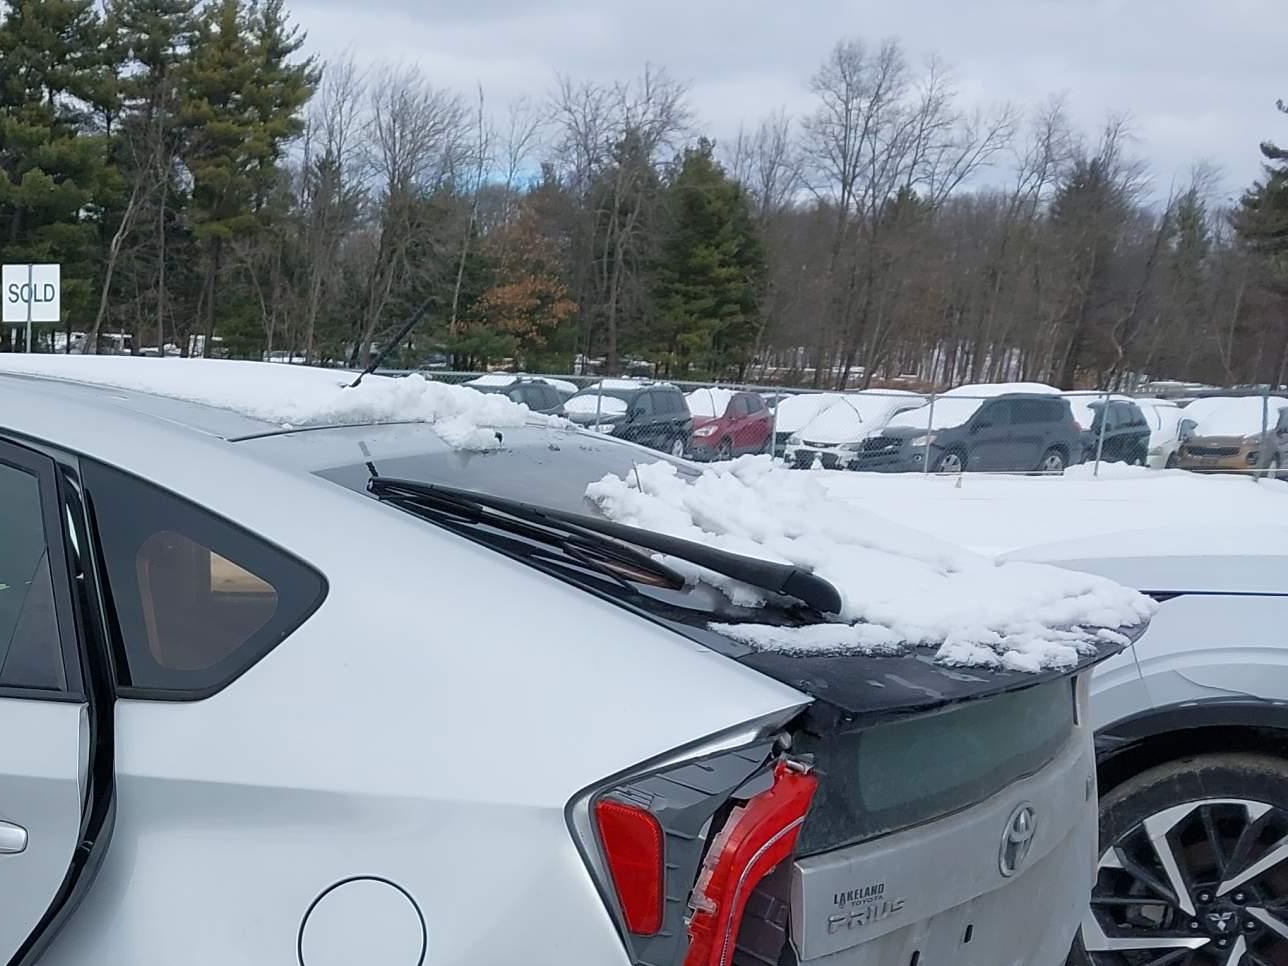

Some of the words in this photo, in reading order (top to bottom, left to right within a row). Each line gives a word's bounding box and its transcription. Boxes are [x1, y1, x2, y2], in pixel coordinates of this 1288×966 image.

[8, 283, 56, 303] SOLD
[833, 883, 885, 906] LAKELAND
[851, 895, 884, 907] TOYOTA
